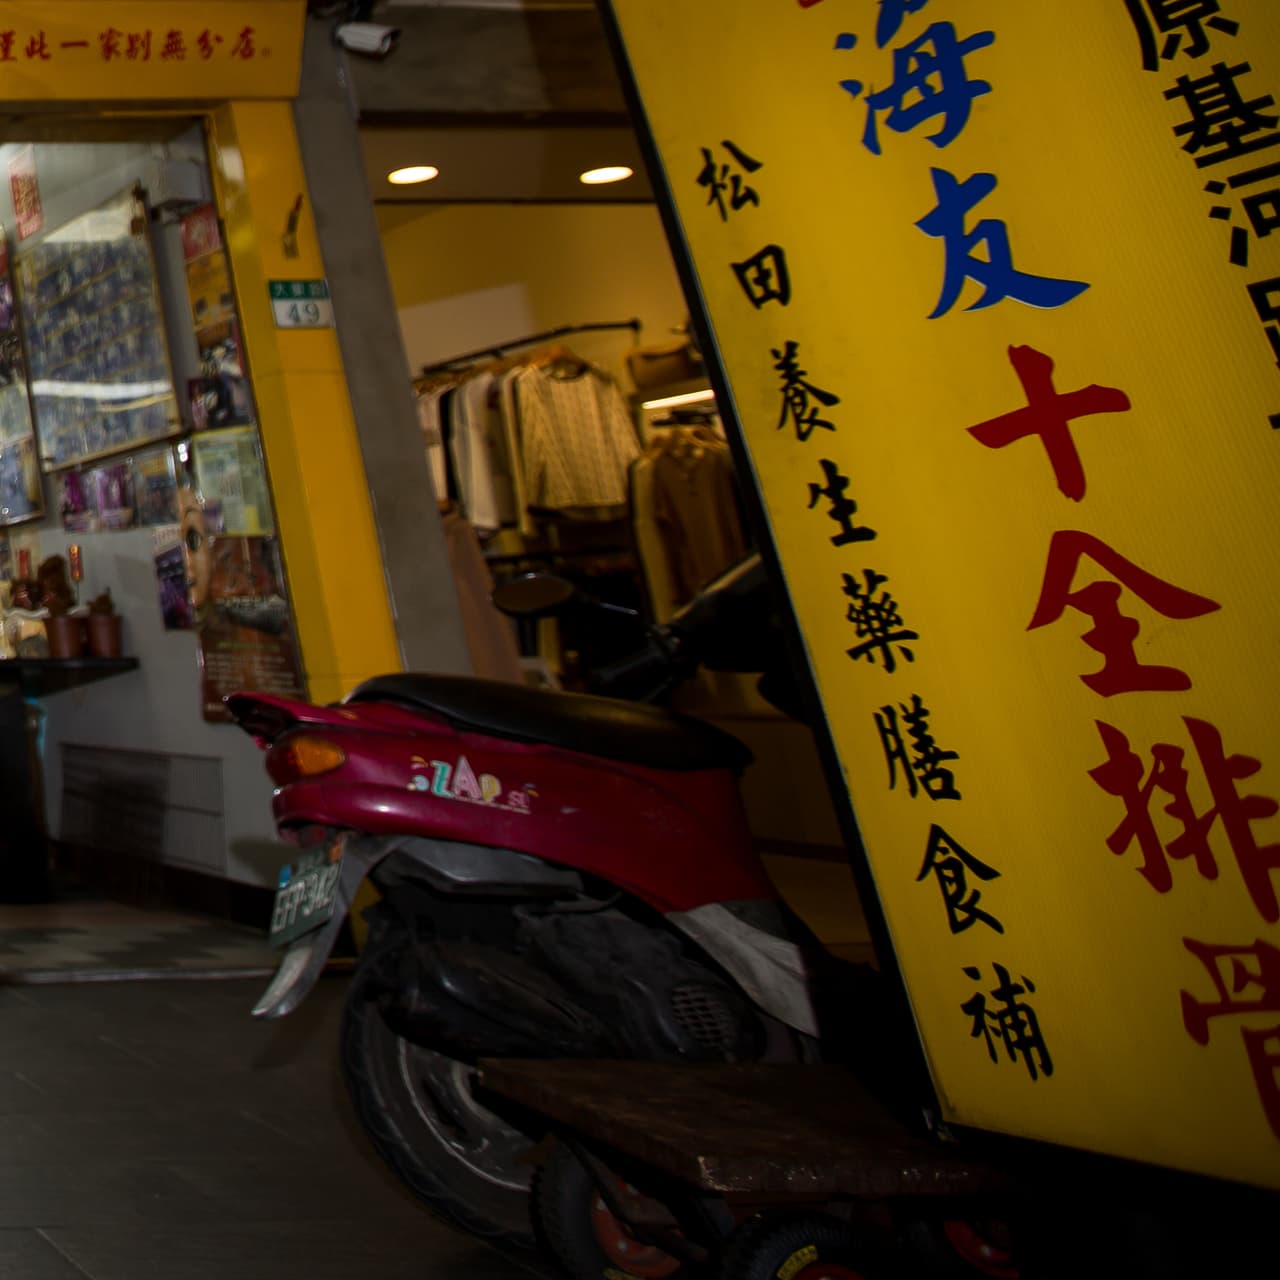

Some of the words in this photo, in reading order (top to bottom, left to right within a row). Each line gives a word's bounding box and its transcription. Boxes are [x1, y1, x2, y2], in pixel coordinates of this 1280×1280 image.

[697, 138, 1053, 1081] 松田養生藥膳食補
